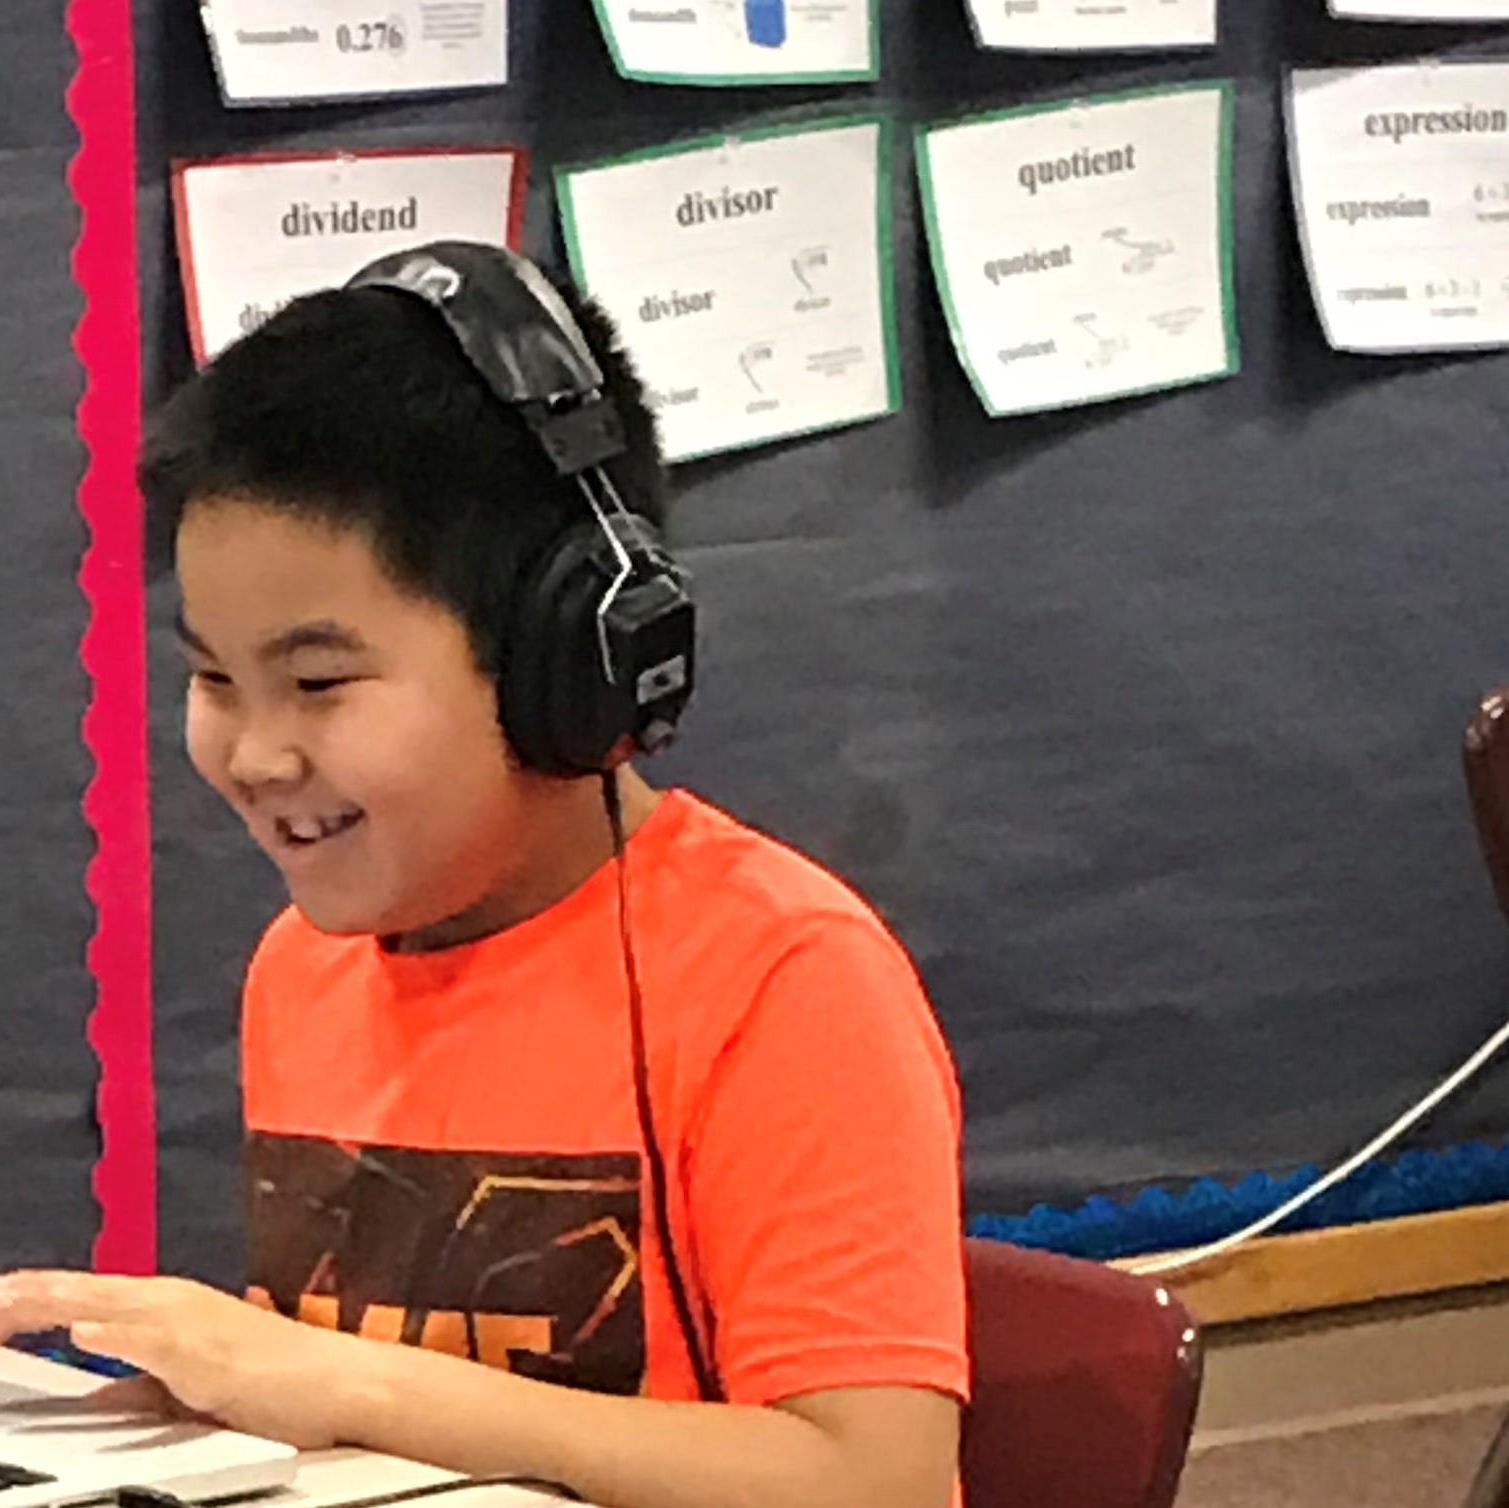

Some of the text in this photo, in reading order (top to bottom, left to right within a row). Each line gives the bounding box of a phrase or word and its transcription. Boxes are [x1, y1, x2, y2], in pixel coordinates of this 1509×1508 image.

[335, 22, 403, 53] 0.276
[1364, 102, 1507, 144] expression
[1018, 143, 1136, 196] quotient
[281, 196, 418, 237] dividend
[675, 185, 779, 228] divisor
[638, 289, 715, 323] divisor
